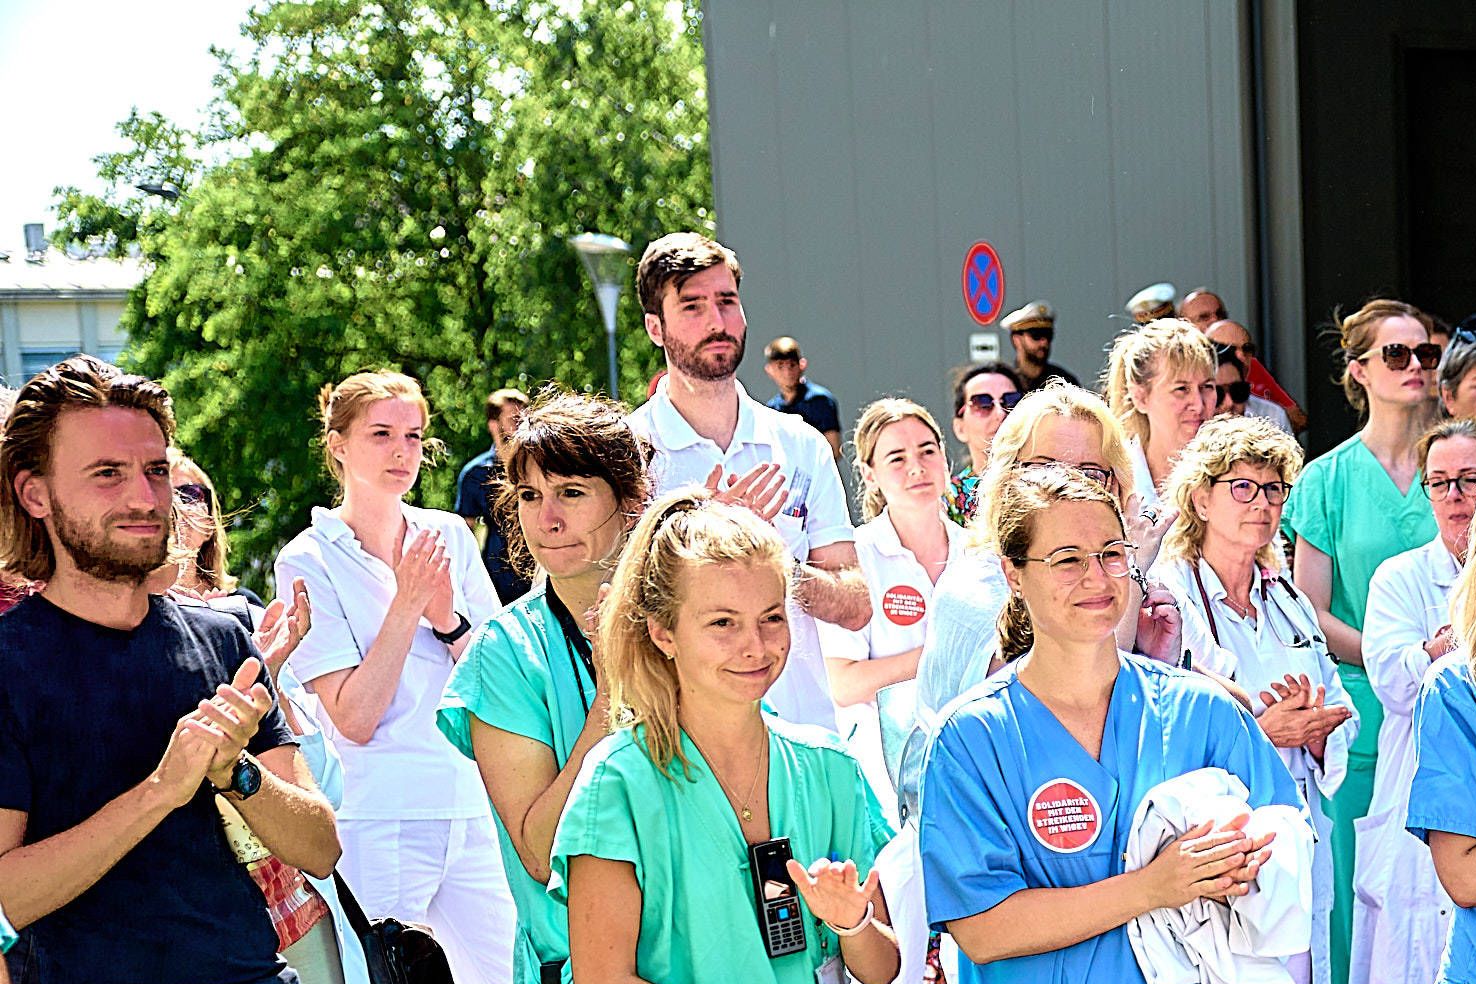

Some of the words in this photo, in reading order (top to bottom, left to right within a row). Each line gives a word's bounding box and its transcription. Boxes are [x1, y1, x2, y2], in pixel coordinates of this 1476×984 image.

[1035, 797, 1089, 811] SOLIDARITÄT
[1047, 808, 1063, 817] MIT
[1065, 806, 1082, 815] DEN
[1036, 813, 1095, 828] STREIKENDEN
[1048, 826, 1058, 835] IM
